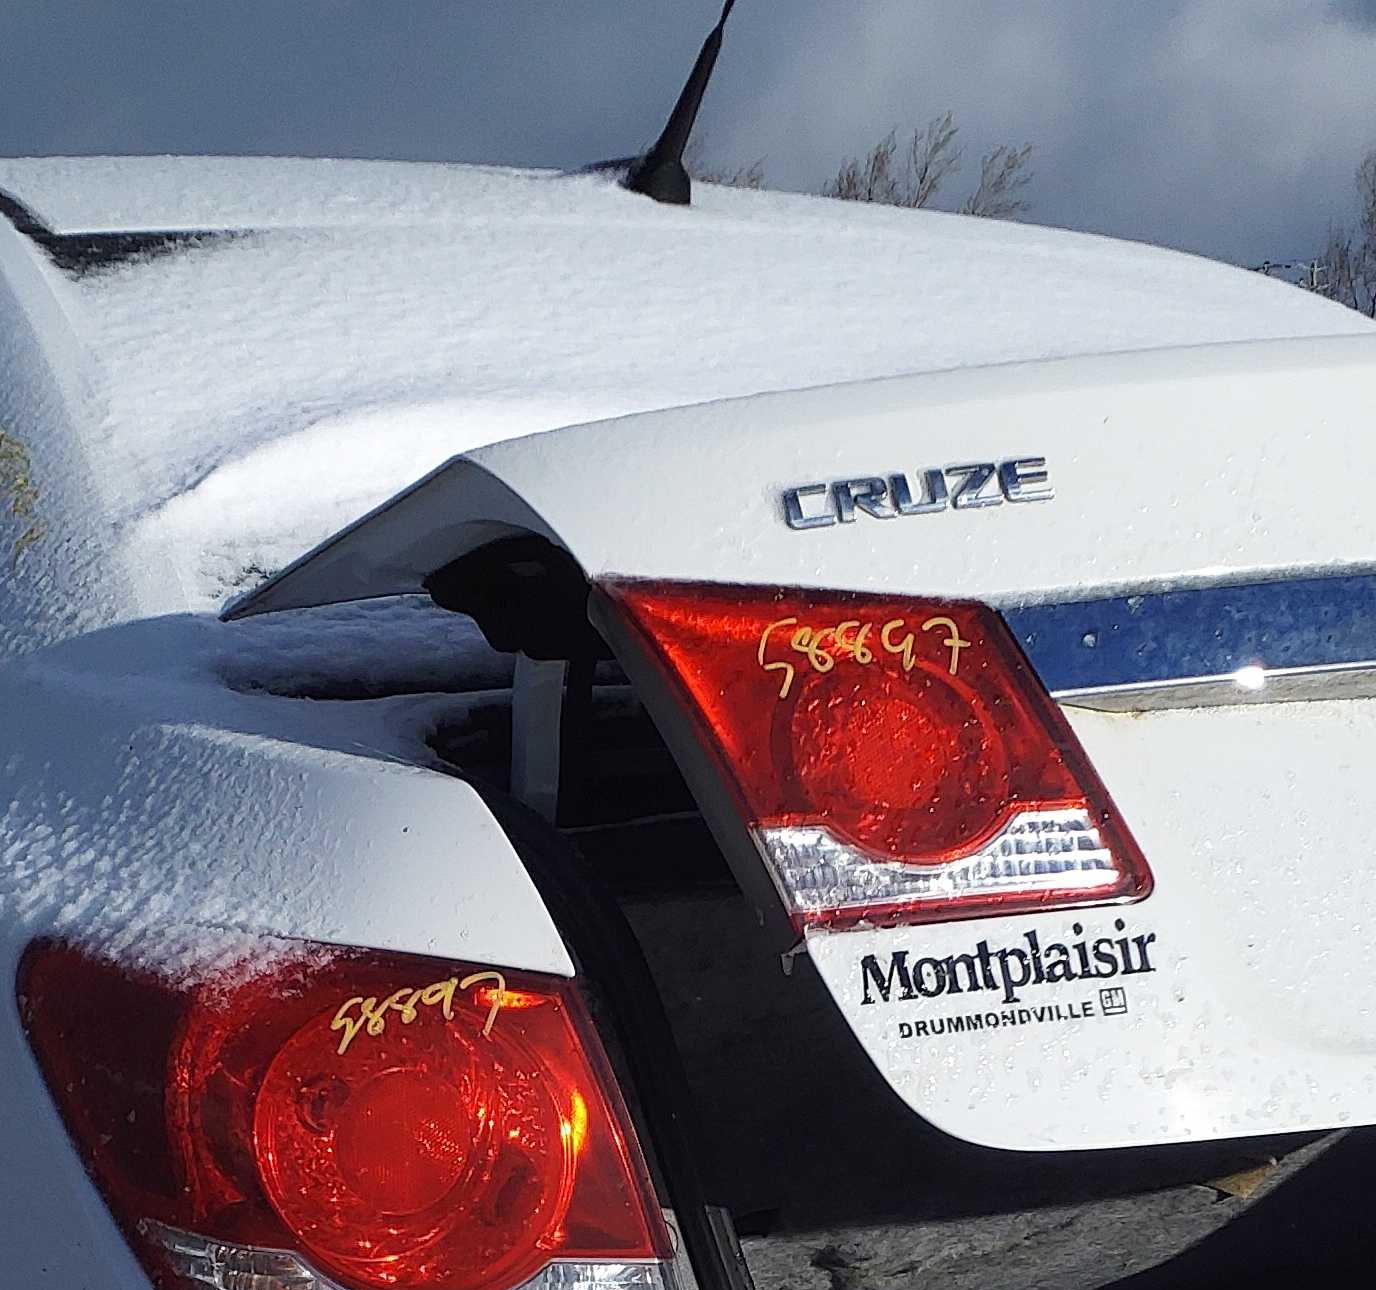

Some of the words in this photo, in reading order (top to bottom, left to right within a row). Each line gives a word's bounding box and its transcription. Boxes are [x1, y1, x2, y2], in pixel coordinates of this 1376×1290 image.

[782, 456, 1056, 530] CRUZE
[758, 616, 972, 698] 58897
[860, 917, 1157, 1005] Montplaisir
[330, 971, 506, 1056] 58897
[898, 1001, 1096, 1038] DRUMMONDVILLE
